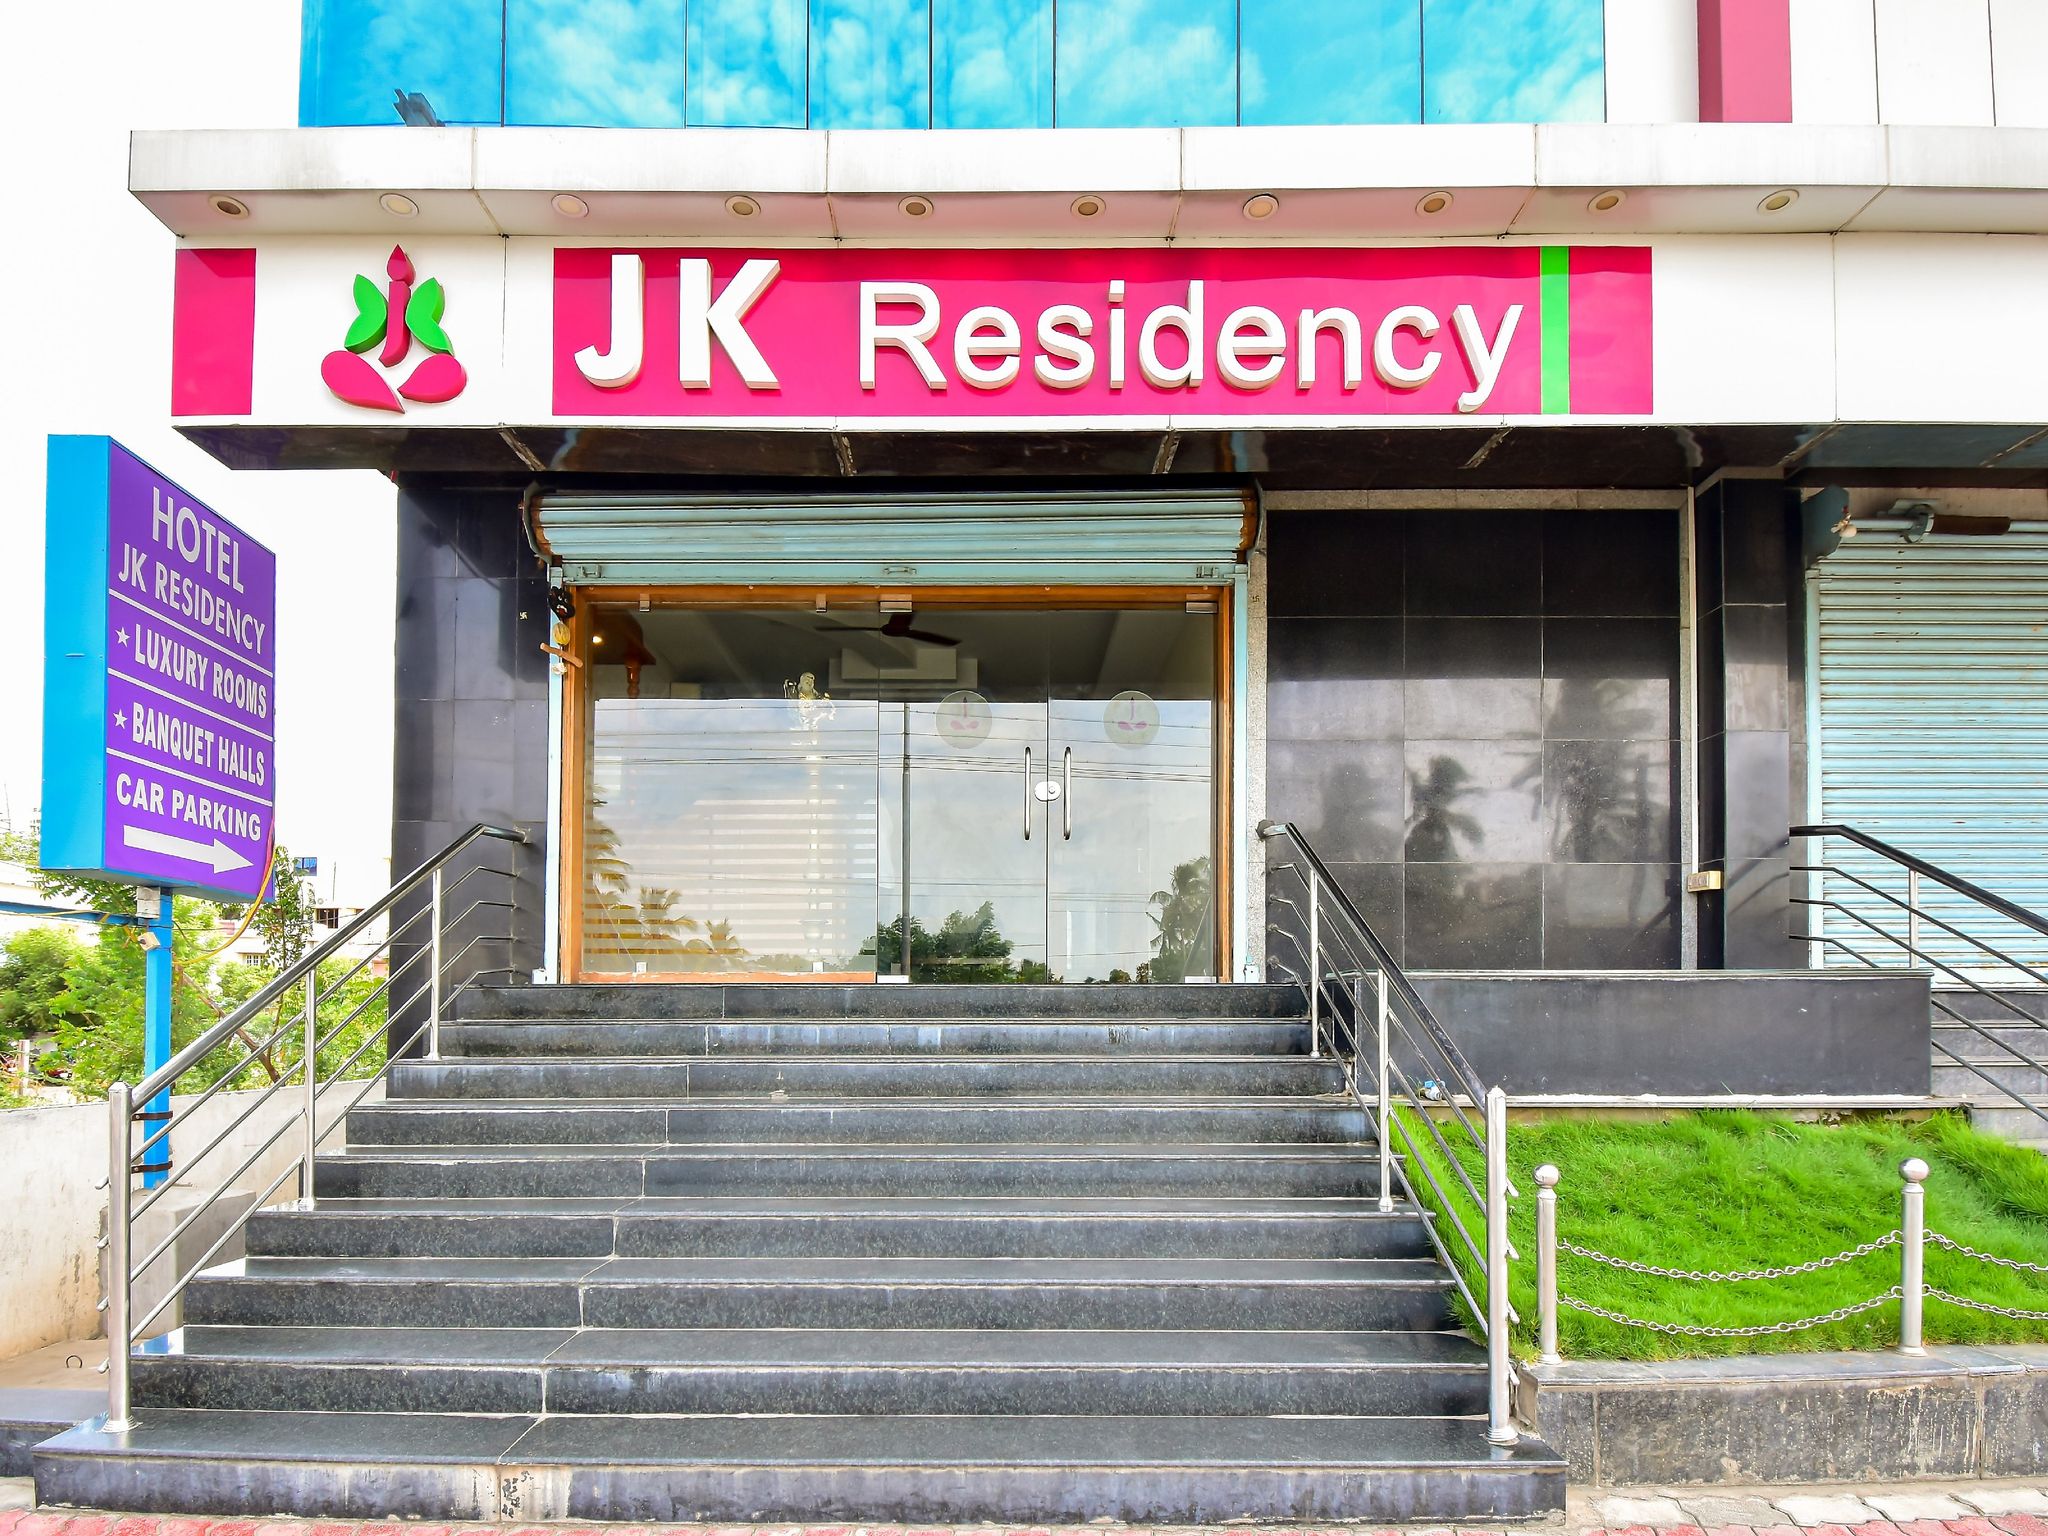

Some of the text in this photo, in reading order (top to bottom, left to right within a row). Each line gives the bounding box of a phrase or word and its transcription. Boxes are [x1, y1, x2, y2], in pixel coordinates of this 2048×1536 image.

[574, 254, 1524, 414] JK Residency
[152, 487, 245, 594] HOTEL
[118, 542, 266, 655] JK RESIDENCY
[134, 623, 267, 719] LUXURY ROOMS
[131, 702, 265, 787] BANQUET HALLS
[115, 772, 262, 841] CAR PARKING
